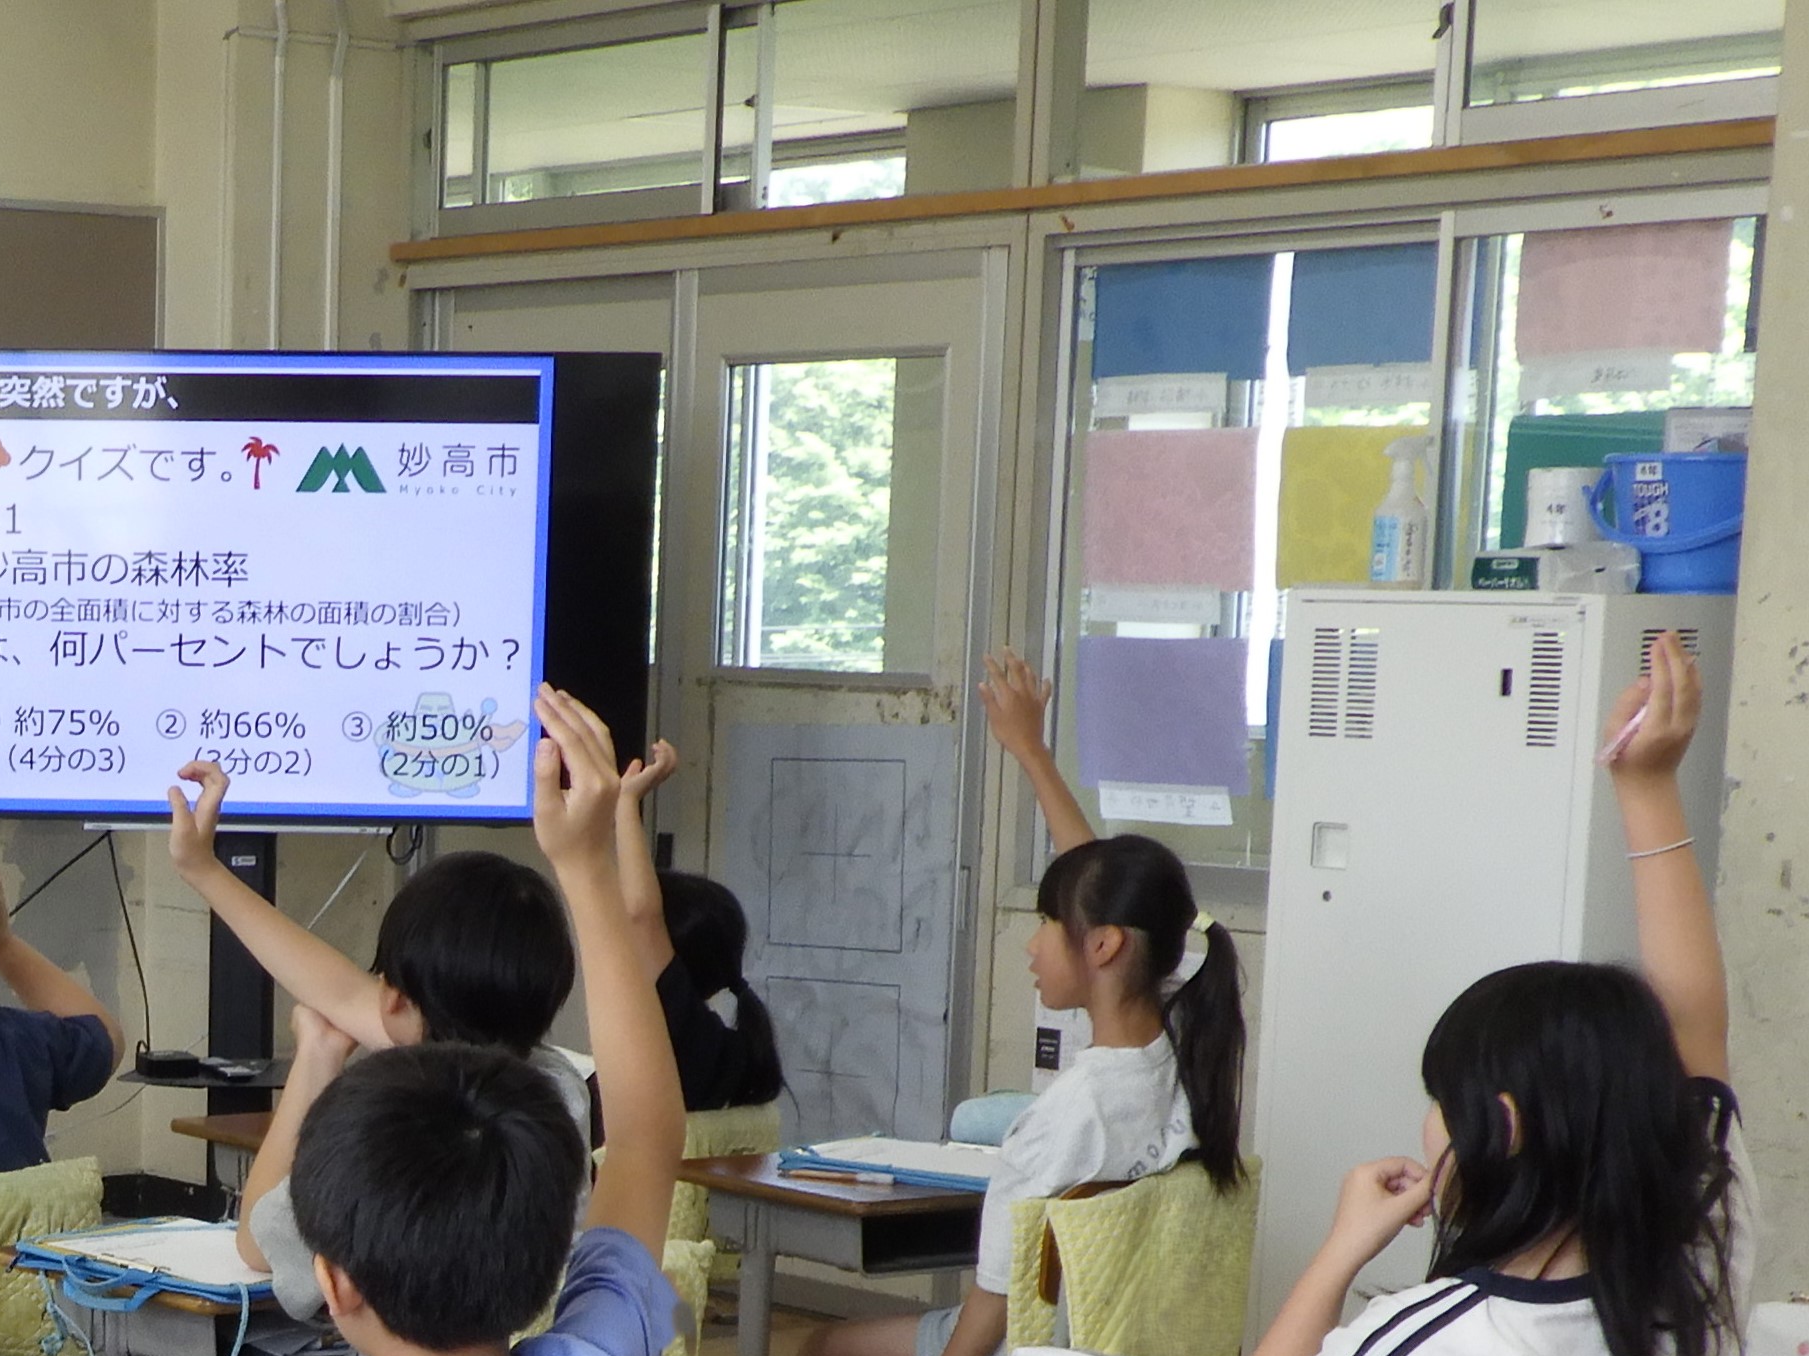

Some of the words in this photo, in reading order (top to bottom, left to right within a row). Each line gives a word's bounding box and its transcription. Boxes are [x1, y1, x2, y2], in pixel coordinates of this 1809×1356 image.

[19, 444, 232, 483] クイズです。
[397, 442, 520, 478] 妙高市
[398, 484, 460, 497] Myoko
[475, 484, 518, 498] City
[13, 706, 120, 737] 約75%
[199, 708, 307, 740] 約66%
[385, 710, 494, 743] 約50%
